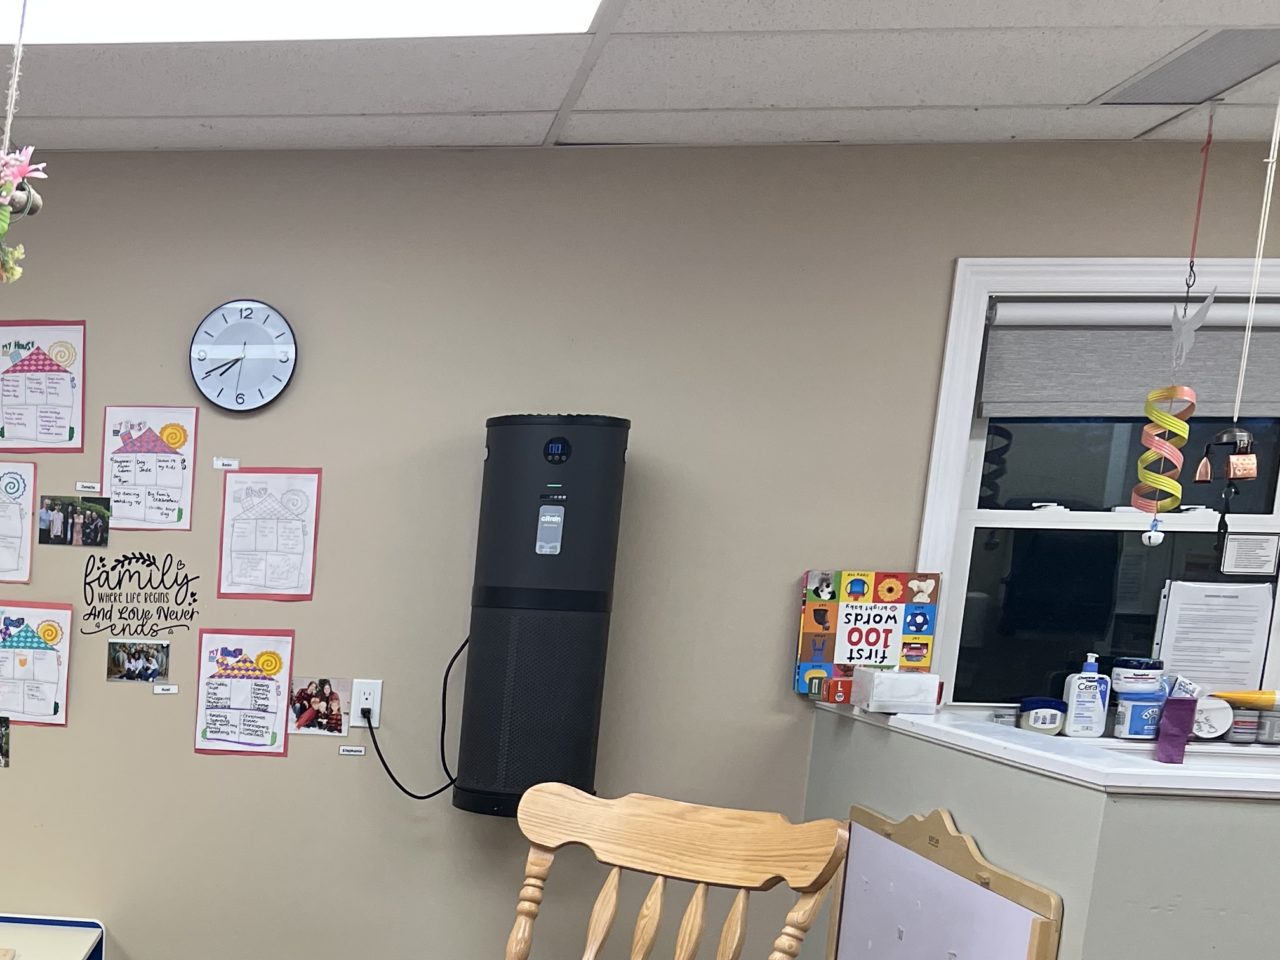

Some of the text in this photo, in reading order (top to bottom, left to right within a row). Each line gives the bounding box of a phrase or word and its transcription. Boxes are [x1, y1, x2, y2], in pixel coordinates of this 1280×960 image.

[239, 308, 254, 320] 12
[197, 349, 208, 362] 9
[279, 351, 290, 364] 3
[236, 392, 245, 405] 6
[84, 554, 200, 606] family
[82, 604, 114, 622] And
[156, 606, 200, 622] Never
[865, 604, 888, 612] bright
[844, 612, 898, 626] words
[848, 626, 893, 649] 100
[846, 648, 888, 664] first
[837, 681, 843, 691] L
[1078, 682, 1107, 692] CeraVe
